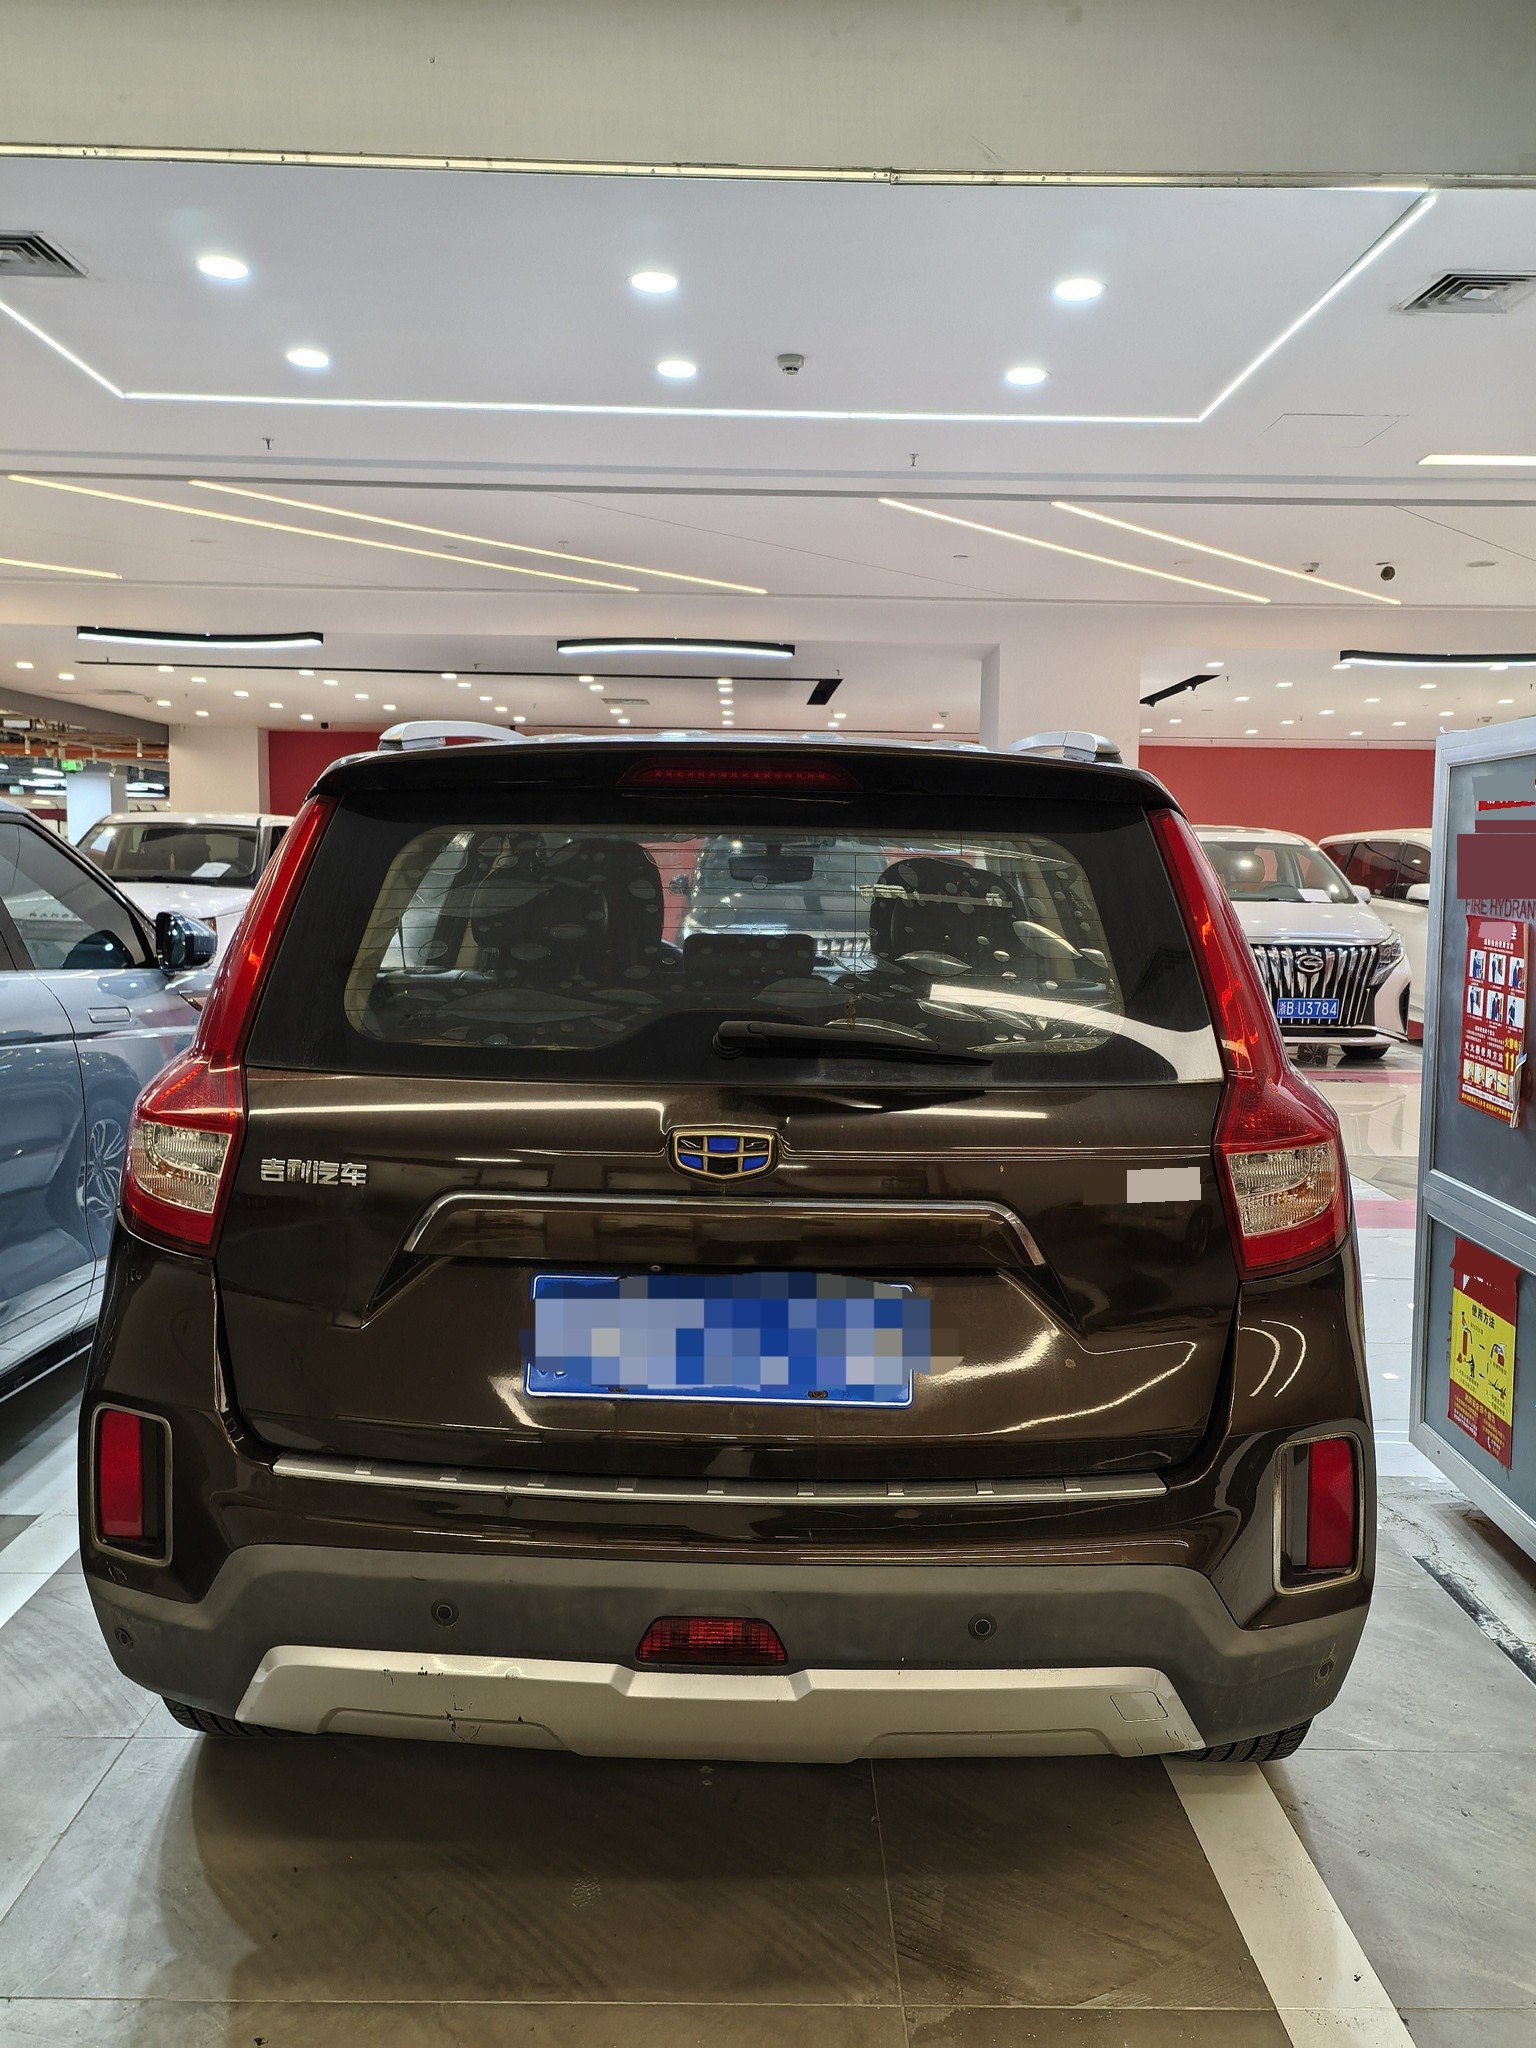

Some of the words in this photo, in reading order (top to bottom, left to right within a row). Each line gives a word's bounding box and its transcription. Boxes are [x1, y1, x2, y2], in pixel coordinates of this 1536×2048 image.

[1464, 1041, 1504, 1063] 灭火器使用方法
[1504, 1037, 1521, 1051] 火警电
[261, 1158, 367, 1186] 吉利汽车
[1472, 1304, 1495, 1330] 使用方法
